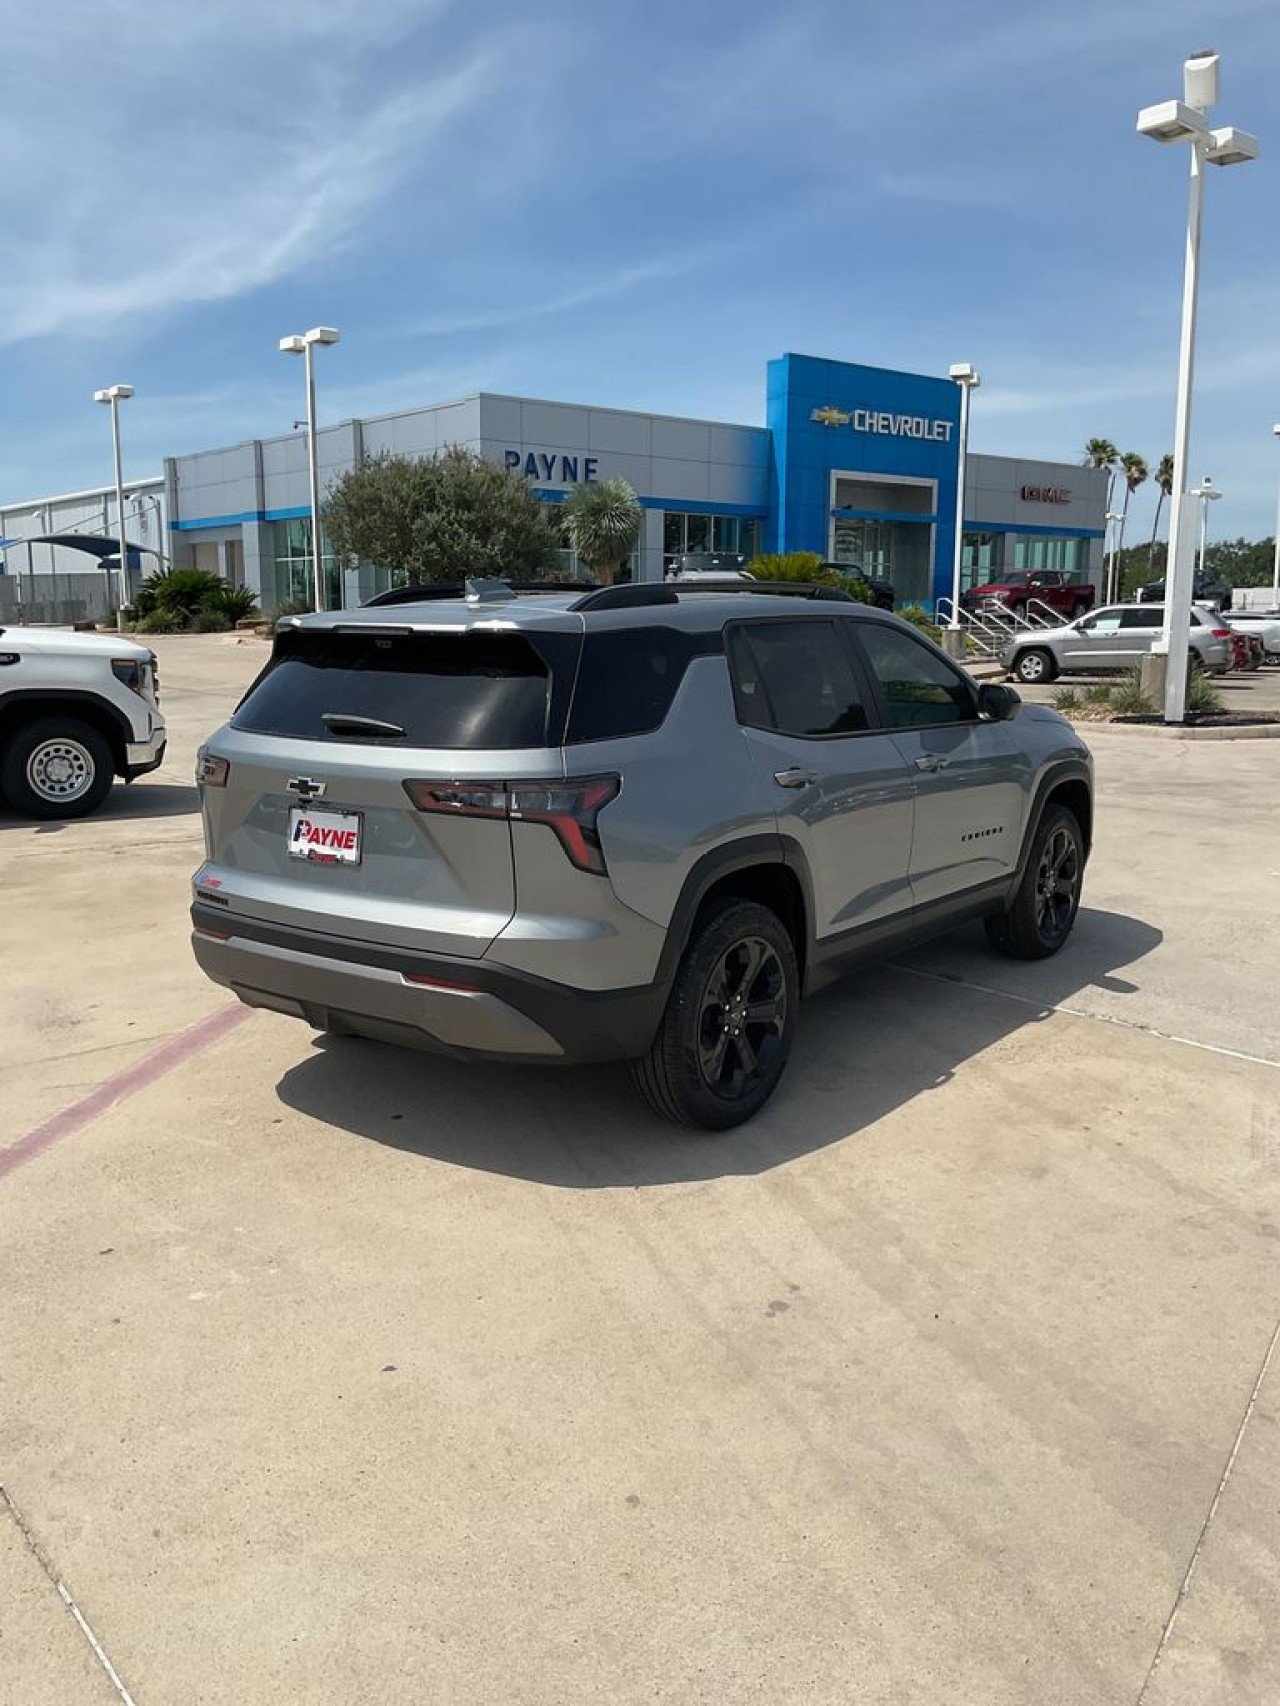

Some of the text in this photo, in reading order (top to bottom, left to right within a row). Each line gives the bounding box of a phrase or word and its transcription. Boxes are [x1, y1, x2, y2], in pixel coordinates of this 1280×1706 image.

[854, 409, 953, 441] CHEVROLET
[504, 449, 598, 483] PAYNE
[293, 819, 356, 848] PAYNE
